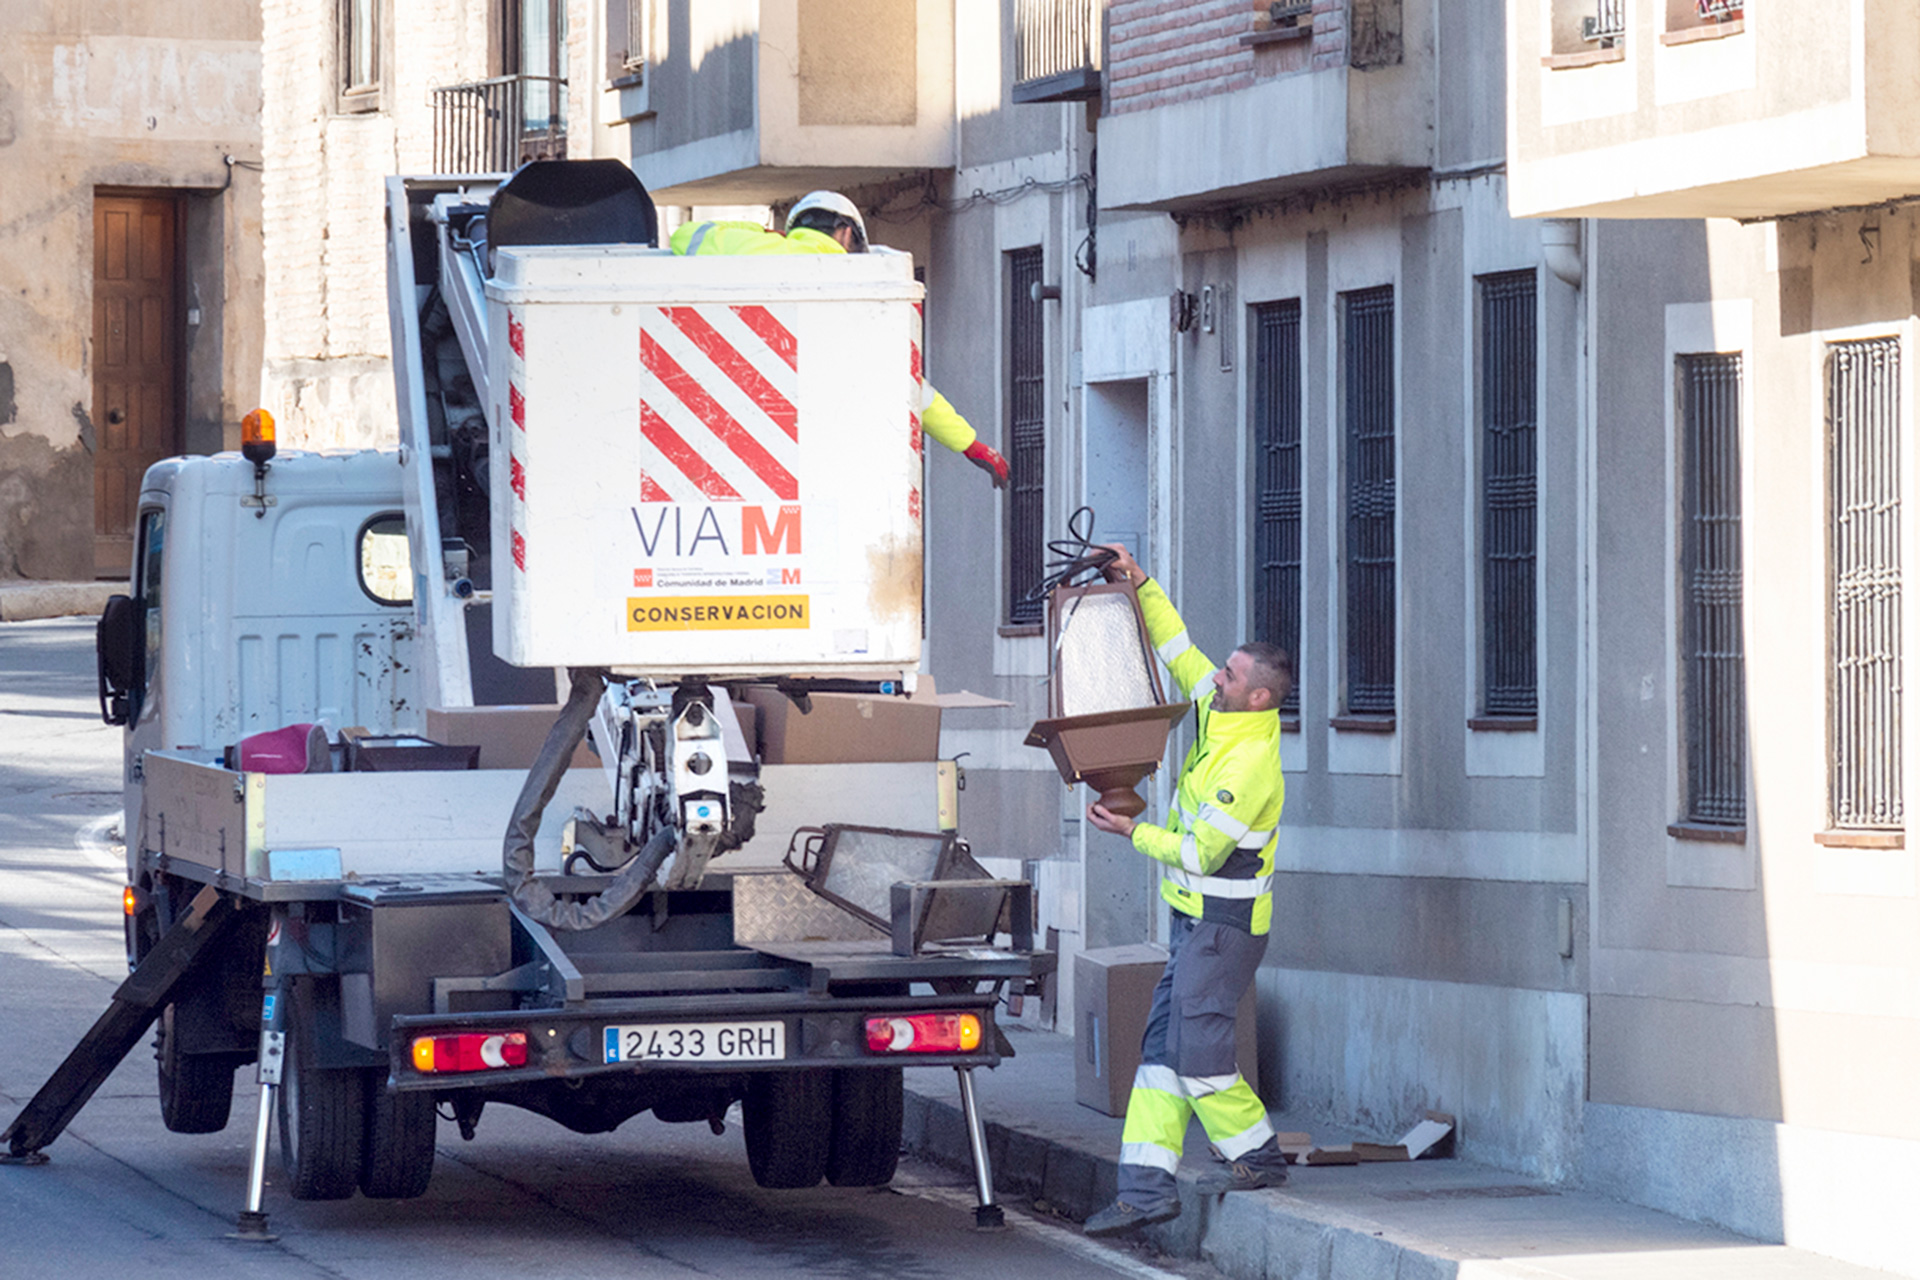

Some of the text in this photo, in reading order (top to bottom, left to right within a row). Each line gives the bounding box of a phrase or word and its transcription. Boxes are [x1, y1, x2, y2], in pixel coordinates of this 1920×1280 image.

[147, 116, 157, 131] 9
[657, 578, 764, 588] Comunidad de Madrid
[632, 604, 803, 622] CONSERVACION
[626, 1029, 704, 1059] 2433
[718, 1028, 775, 1056] GRH
